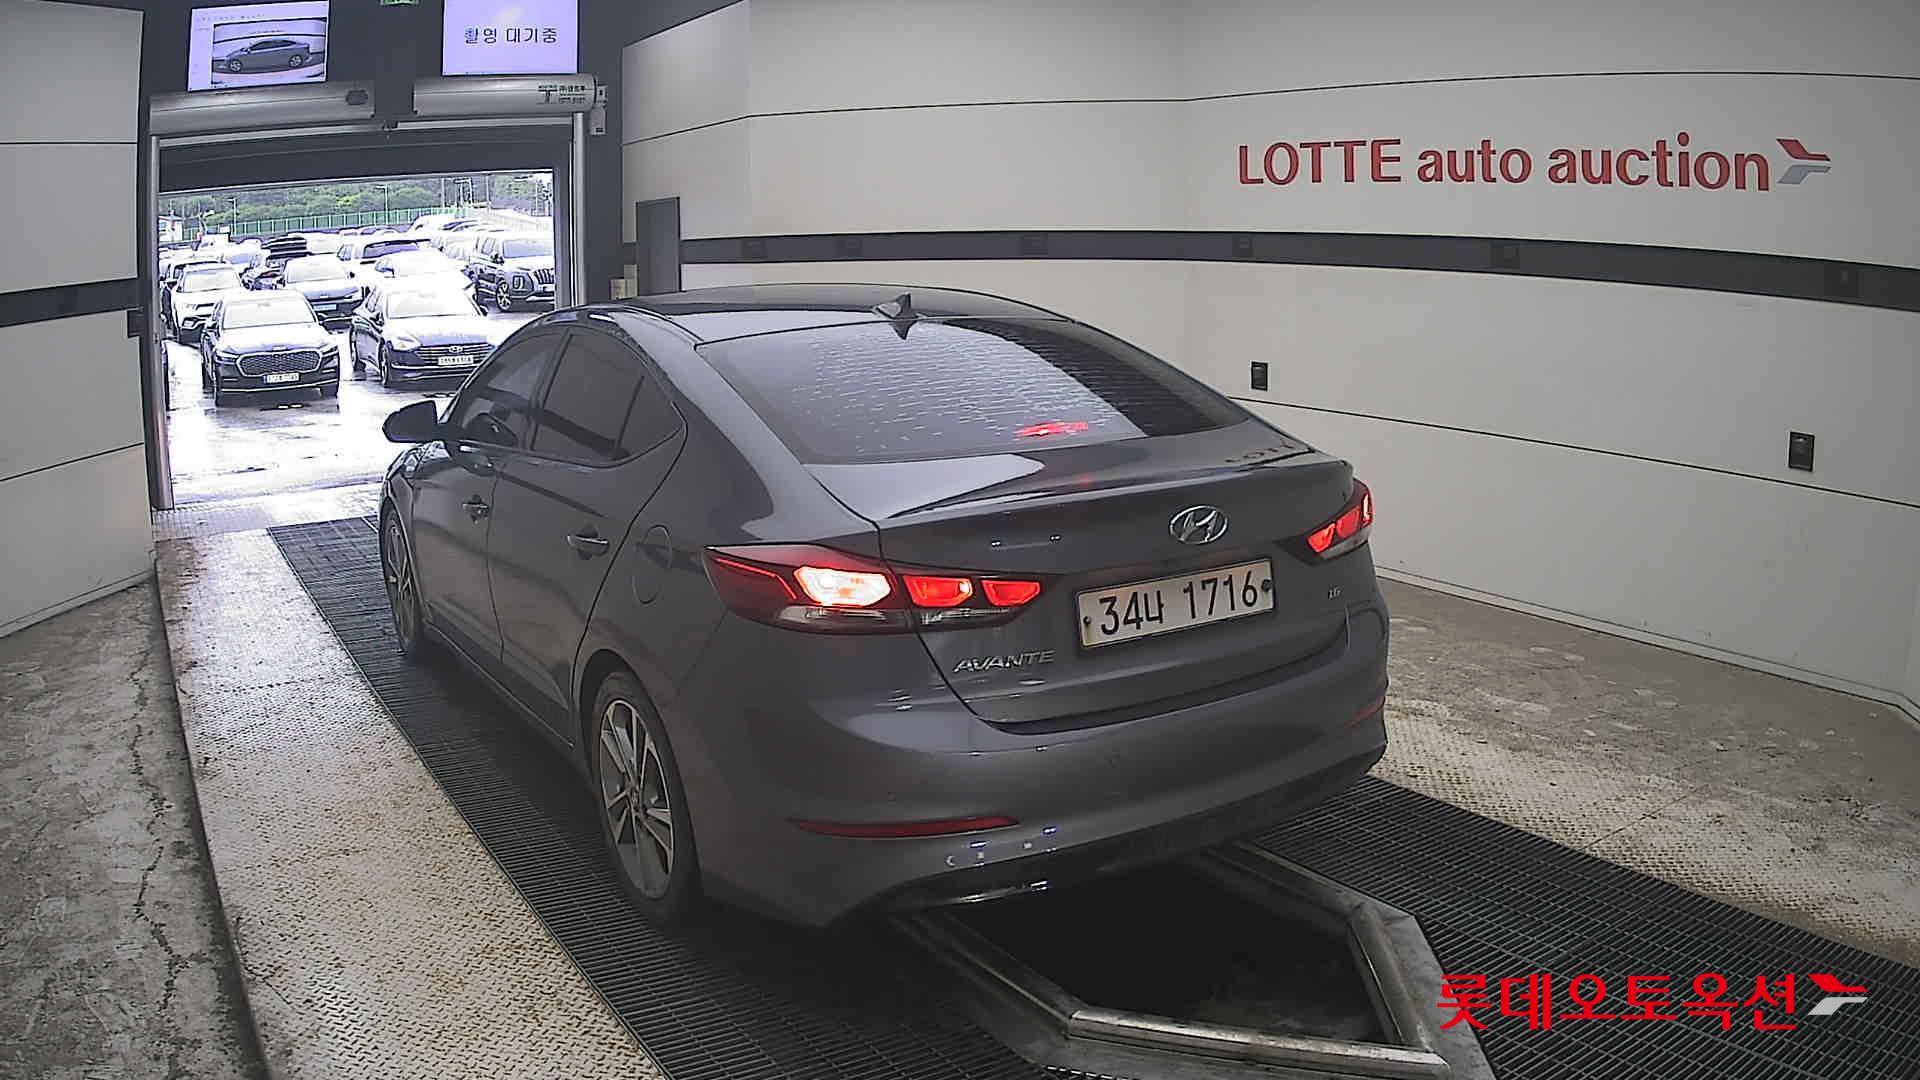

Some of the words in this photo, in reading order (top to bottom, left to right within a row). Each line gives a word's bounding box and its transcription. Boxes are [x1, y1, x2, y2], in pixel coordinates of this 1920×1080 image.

[506, 27, 557, 44] 대기중
[1239, 139, 1401, 186] LOTTE
[1416, 139, 1532, 183] auto
[1547, 132, 1770, 191] auction
[1099, 590, 1165, 635] 34나
[1183, 570, 1258, 619] 1716
[952, 650, 1055, 672] AVANTE
